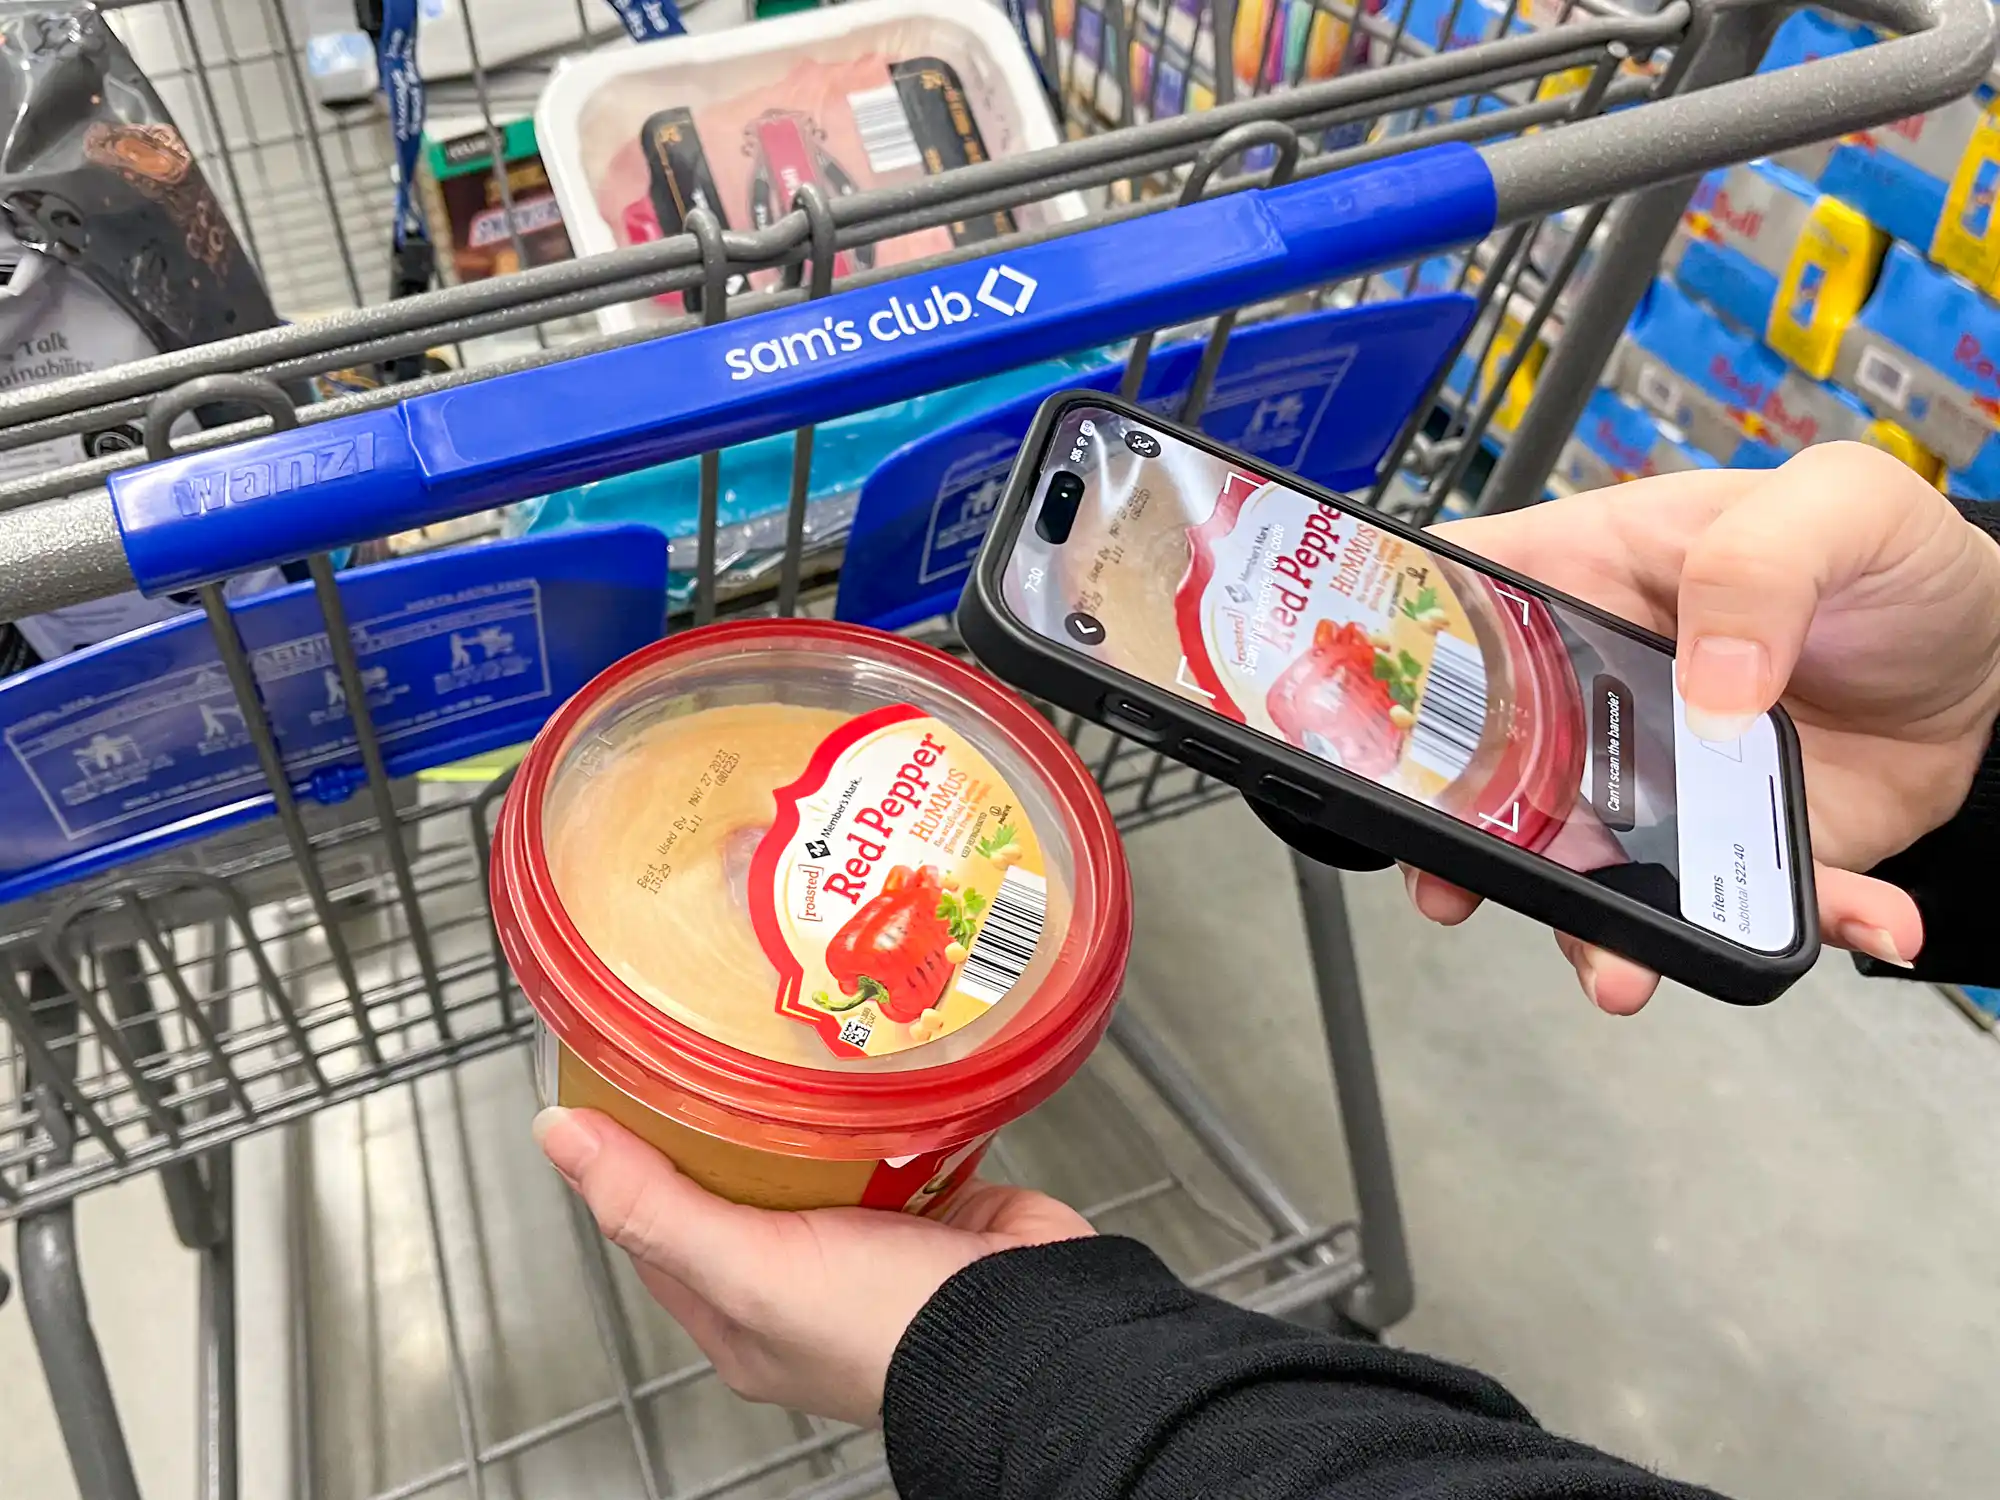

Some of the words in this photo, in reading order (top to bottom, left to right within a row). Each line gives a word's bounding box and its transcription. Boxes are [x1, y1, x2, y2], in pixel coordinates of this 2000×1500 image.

[724, 316, 863, 381] sam's
[173, 431, 376, 518] wanzl
[1270, 523, 1286, 551] code
[1024, 566, 1045, 593] 7:30
[1606, 691, 1620, 740] barcode?
[1607, 739, 1620, 758] the
[854, 732, 946, 840] Pepper
[1608, 757, 1620, 782] scan
[1606, 782, 1621, 812] Can't
[636, 863, 659, 889] Best
[656, 830, 678, 855] Used
[700, 772, 713, 787] 27
[709, 748, 729, 774] 2023
[820, 798, 850, 839] Member's
[648, 863, 672, 895] 13:29
[822, 832, 887, 905] Red
[1733, 843, 1748, 885] $22.40
[1711, 874, 1725, 910] items
[1738, 883, 1751, 935] Subtotal
[1713, 909, 1726, 924] 5
